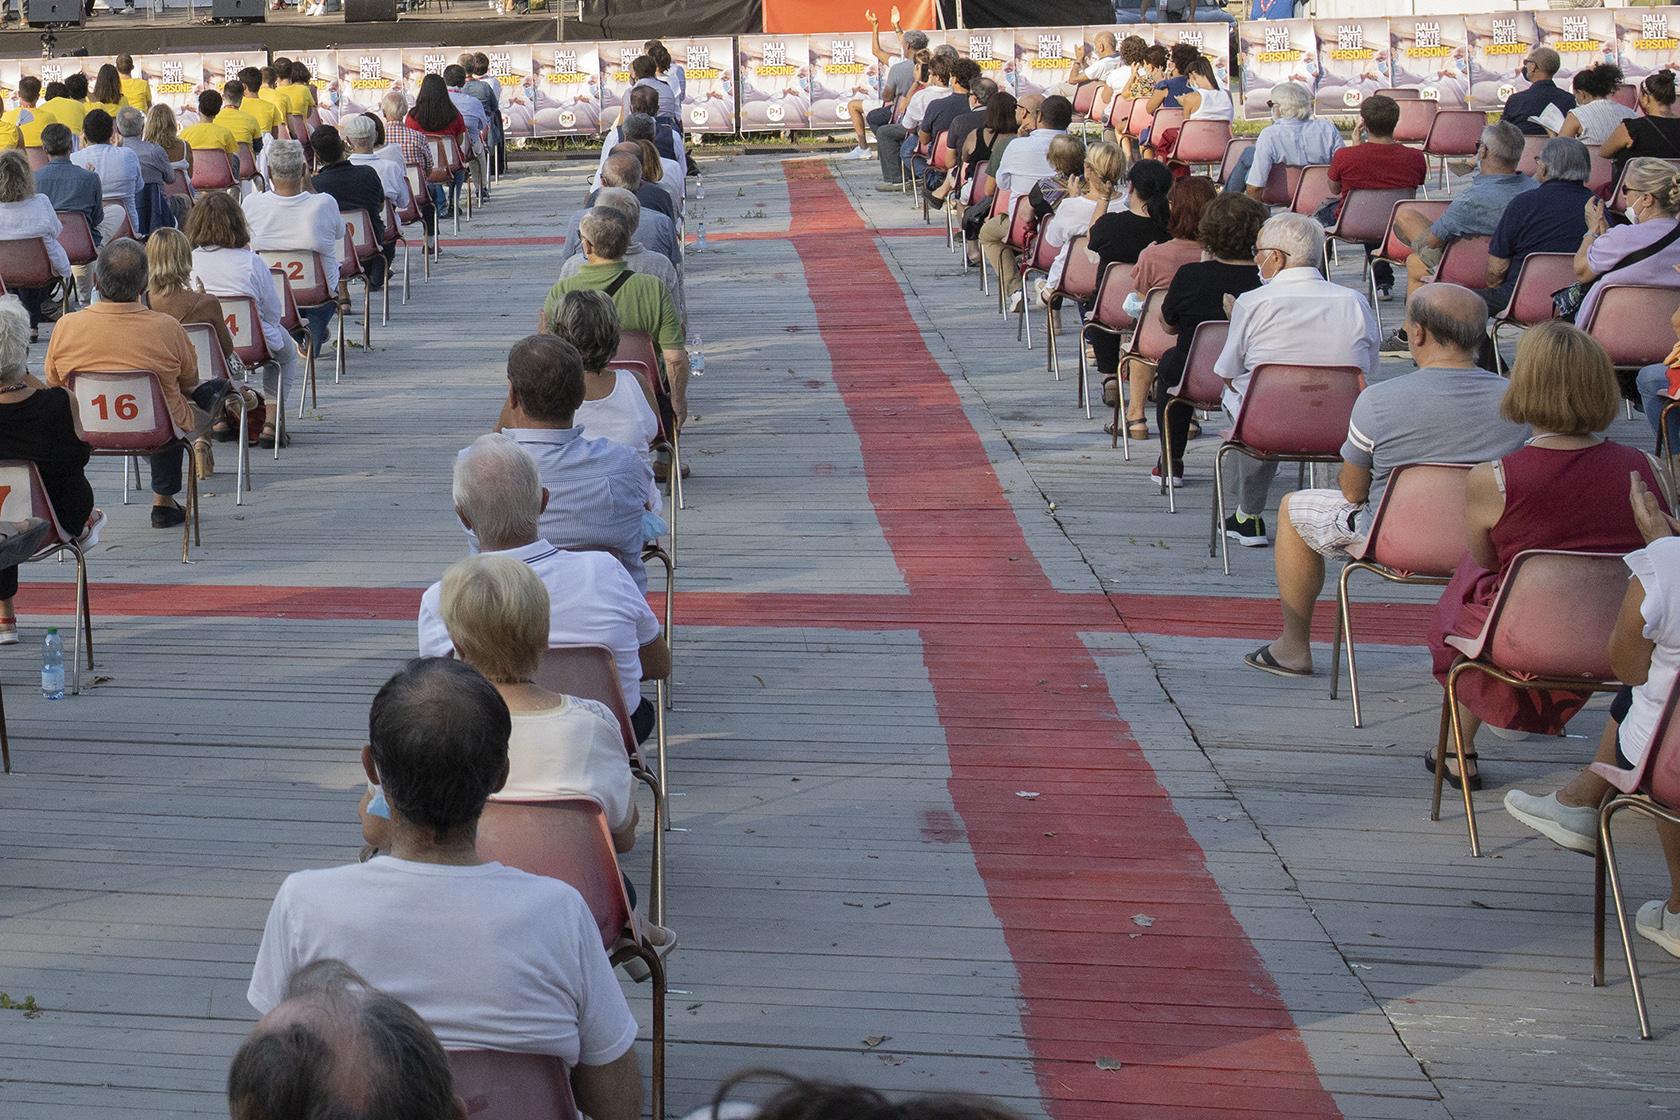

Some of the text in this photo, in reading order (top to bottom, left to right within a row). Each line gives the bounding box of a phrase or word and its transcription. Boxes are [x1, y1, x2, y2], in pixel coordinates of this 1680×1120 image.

[1563, 16, 1588, 25] DALLA
[1642, 14, 1667, 23] DALLA
[1415, 22, 1439, 31] DALLA
[1492, 19, 1516, 28] DALLA
[1642, 23, 1668, 32] PARTE
[1265, 27, 1288, 36] DALLA
[1337, 24, 1362, 34] DALLA
[1493, 27, 1517, 36] PARTE
[1563, 24, 1588, 33] PARTE
[1265, 35, 1289, 44] PARTE
[1338, 33, 1362, 42] PARTE
[1415, 31, 1440, 40] PARTE
[1563, 32, 1588, 41] DELLE
[1642, 31, 1668, 40] DELLE
[832, 40, 854, 49] DALLA
[1415, 39, 1440, 48] DELLE
[1493, 36, 1517, 45] DELLE
[1634, 38, 1678, 50] PERSONE
[763, 42, 785, 51] DALLA
[1265, 43, 1289, 52] DELLE
[1338, 41, 1363, 50] DELLE
[1485, 43, 1527, 55] PERSONE
[1554, 40, 1600, 52] PERSONE
[554, 50, 576, 59] DALLA
[764, 50, 785, 59] PARTE
[832, 48, 855, 56] PARTE
[1257, 50, 1301, 62] PERSONE
[1329, 49, 1373, 61] PERSONE
[1407, 46, 1450, 58] PERSONE
[359, 56, 381, 65] DALLA
[555, 58, 577, 66] PARTE
[764, 58, 785, 66] DELLE
[832, 56, 855, 64] DELLE
[162, 61, 182, 69] DALLA
[360, 64, 381, 73] PARTE
[555, 65, 577, 73] DELLE
[163, 68, 183, 77] PARTE
[755, 65, 795, 76] PERSONE
[163, 76, 184, 84] DELLE
[360, 71, 382, 80] DELLE
[547, 72, 586, 83] PERSONE
[156, 83, 193, 94] PERSONE
[351, 79, 390, 90] PERSONE
[91, 394, 139, 421] 16
